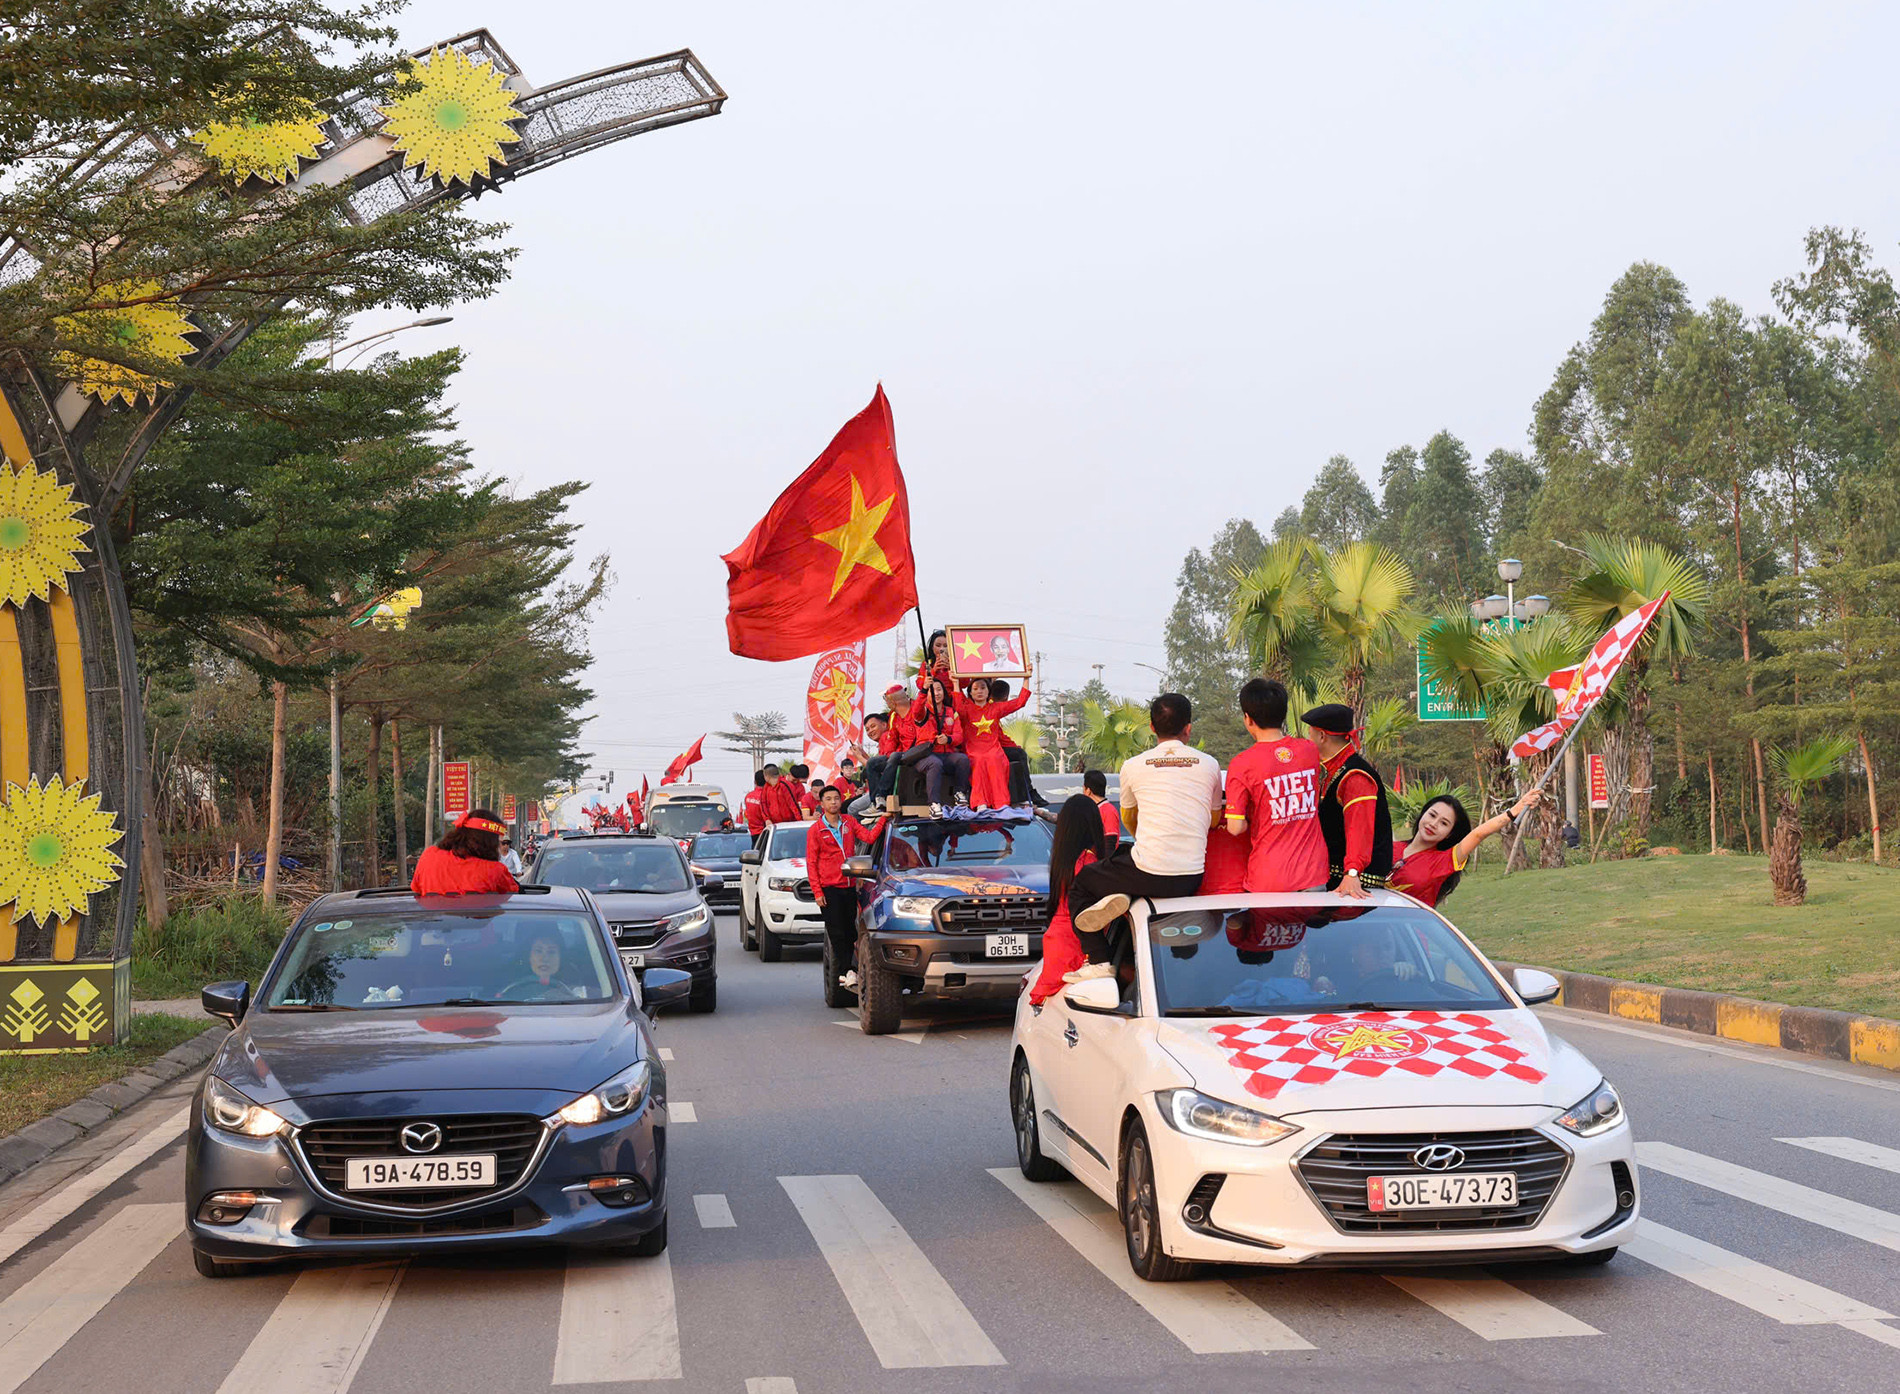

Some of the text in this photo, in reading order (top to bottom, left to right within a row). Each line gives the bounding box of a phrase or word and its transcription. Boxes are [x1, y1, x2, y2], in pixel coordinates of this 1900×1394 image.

[1264, 768, 1315, 799] VIET
[1269, 790, 1317, 820] NAM
[990, 945, 1024, 956] 061.55
[998, 935, 1017, 945] 30H
[362, 1161, 482, 1184] 19A-478.59
[1388, 1177, 1513, 1206] 30E-473.73
